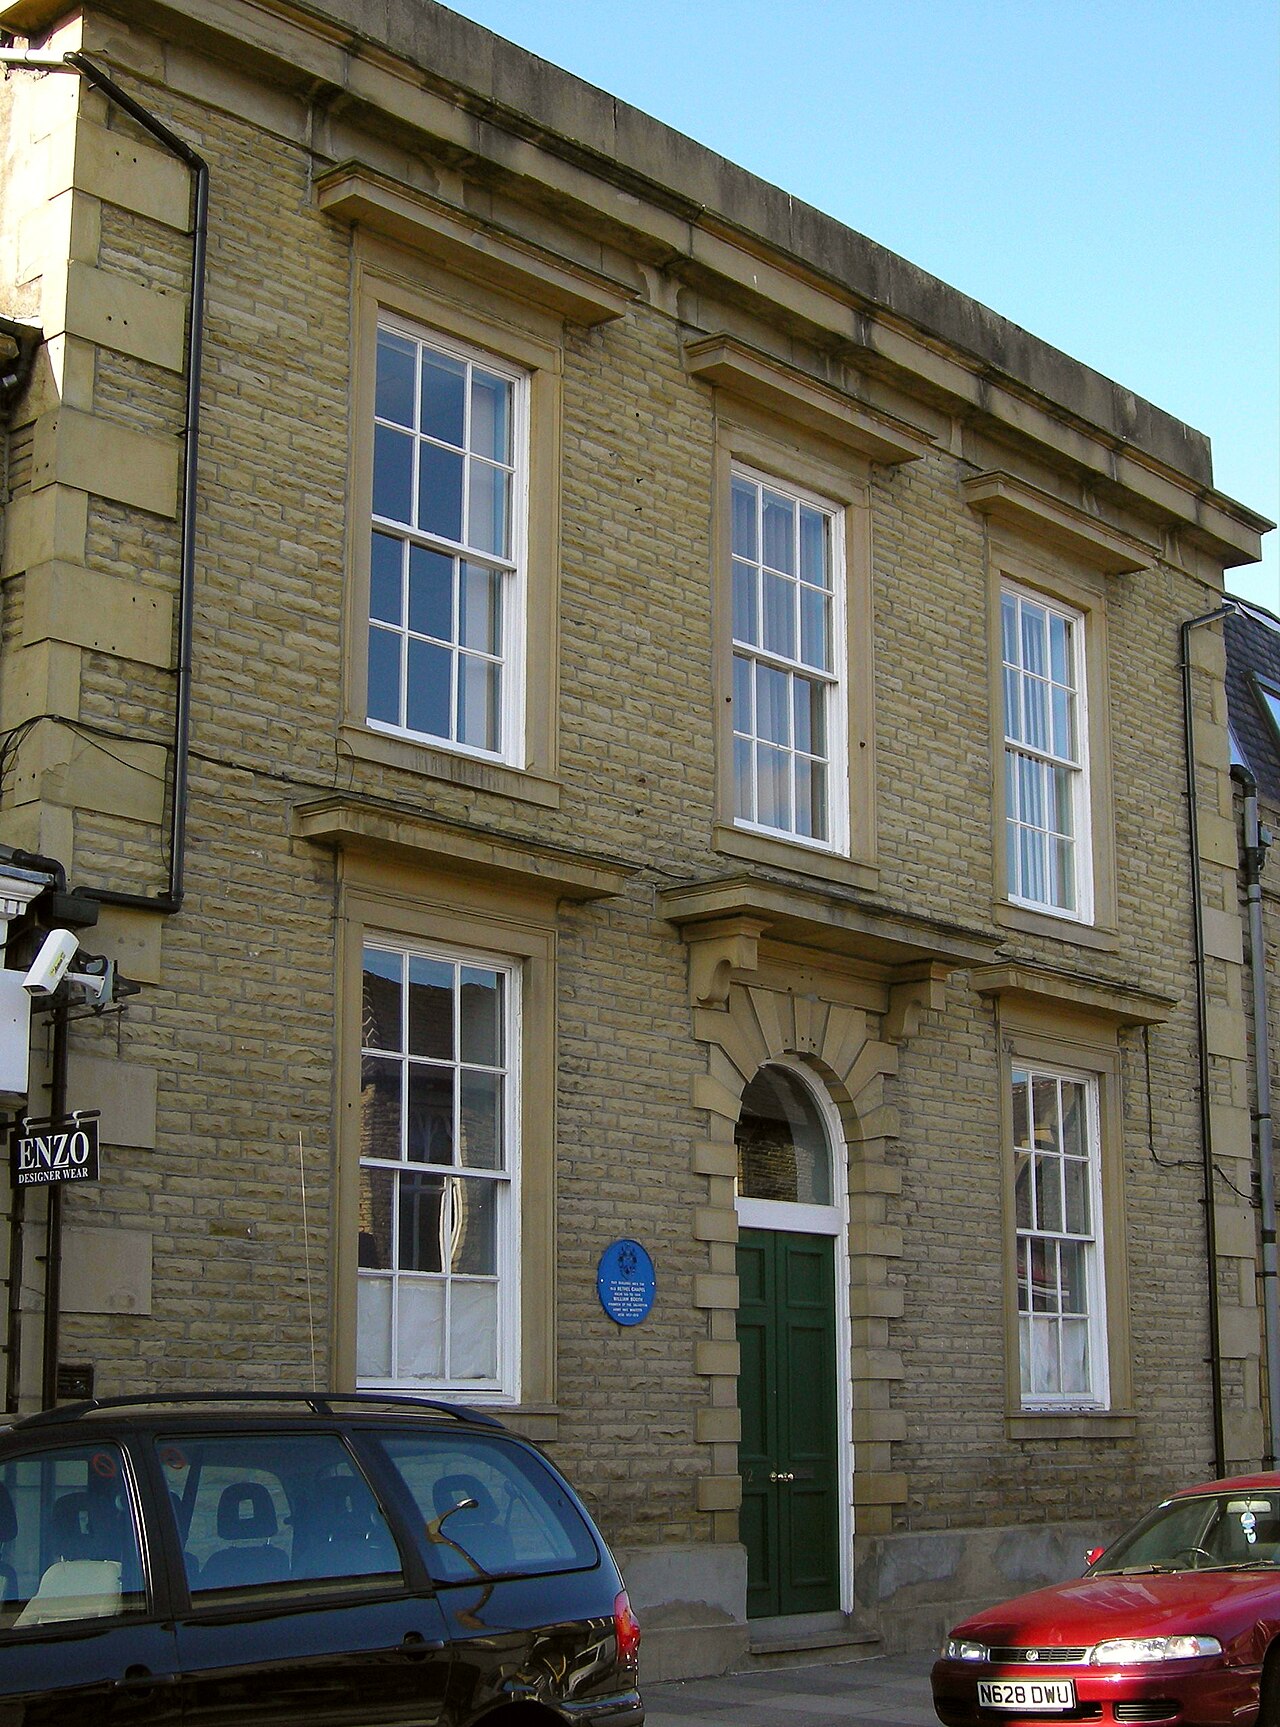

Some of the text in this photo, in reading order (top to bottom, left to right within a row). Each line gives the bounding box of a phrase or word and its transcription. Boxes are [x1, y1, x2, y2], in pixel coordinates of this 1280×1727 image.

[18, 1131, 89, 1170] ENZO
[18, 1167, 89, 1184] DESIGNER WEAR
[980, 1684, 1069, 1704] N628 DWU
